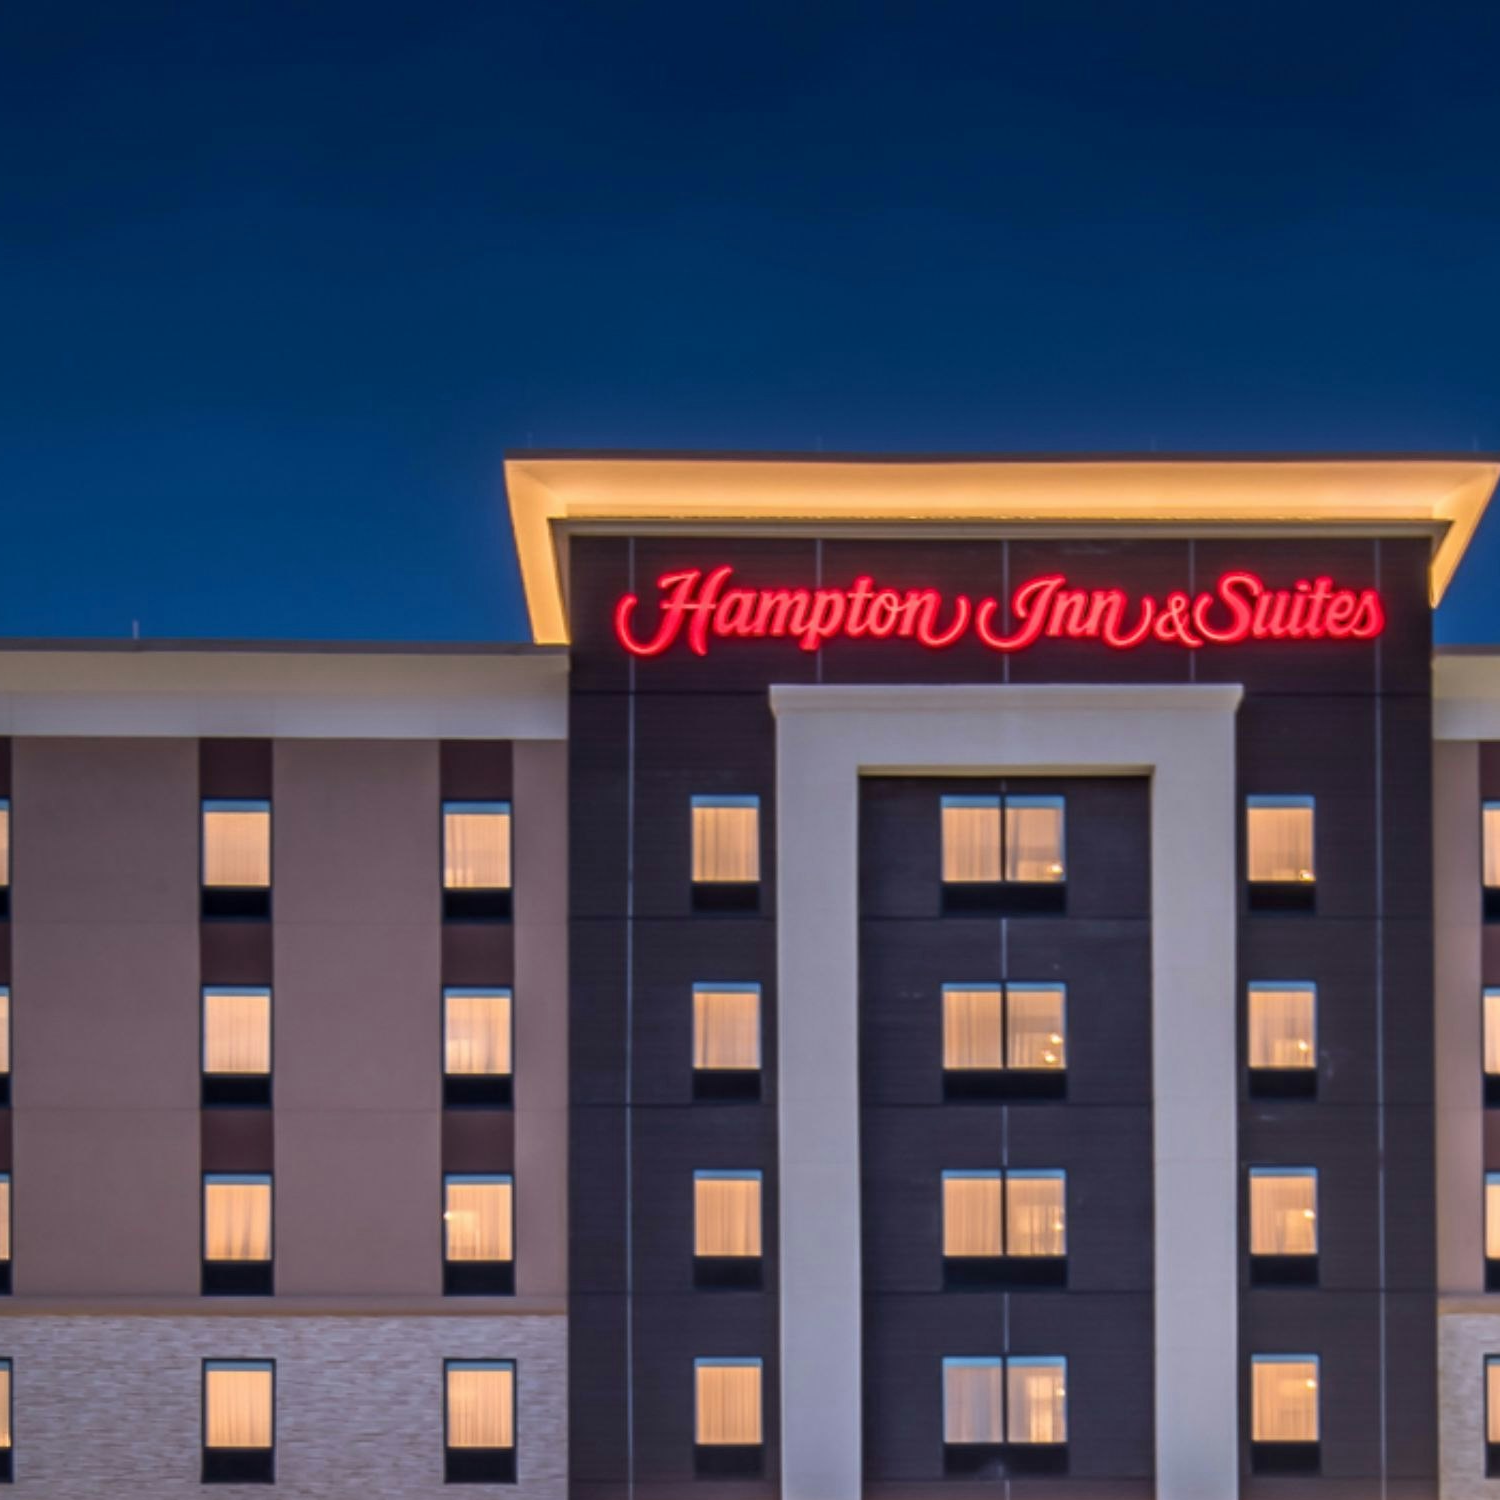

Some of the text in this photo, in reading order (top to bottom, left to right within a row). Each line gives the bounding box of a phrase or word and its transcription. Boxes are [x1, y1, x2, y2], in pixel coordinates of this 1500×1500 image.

[615, 565, 970, 656] Hampton
[974, 573, 1153, 651] Inn
[1192, 570, 1385, 643] Suites
